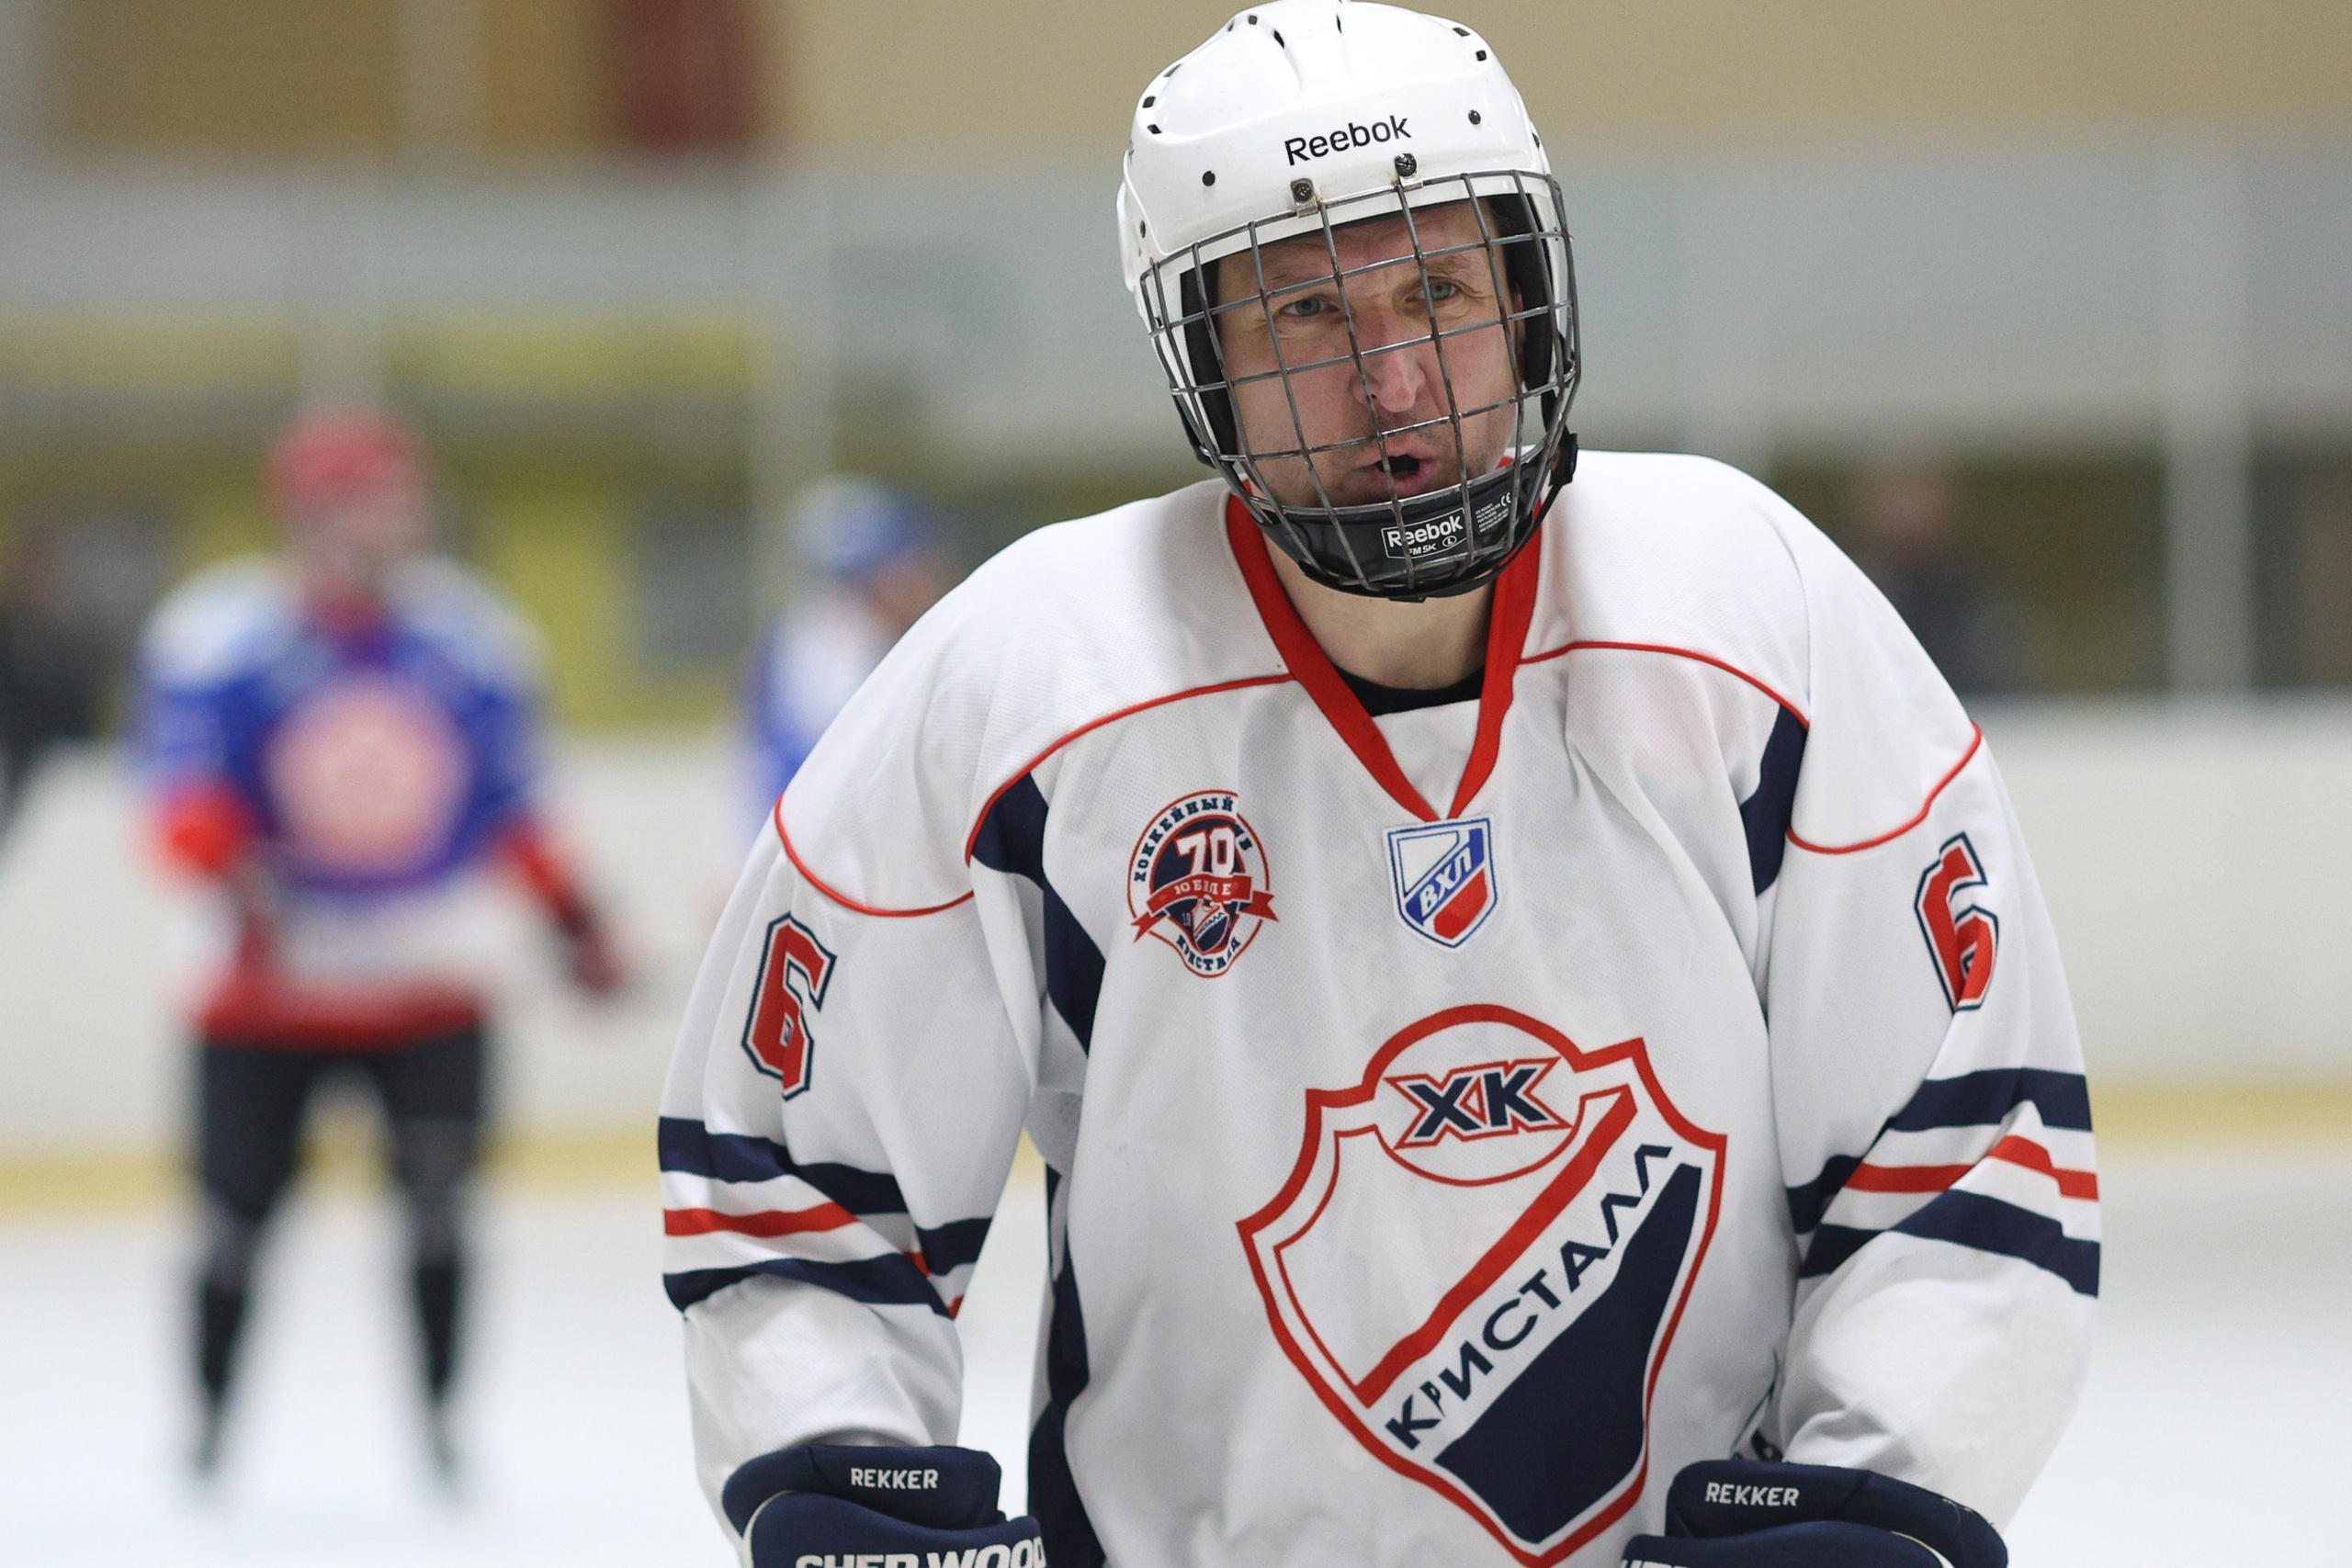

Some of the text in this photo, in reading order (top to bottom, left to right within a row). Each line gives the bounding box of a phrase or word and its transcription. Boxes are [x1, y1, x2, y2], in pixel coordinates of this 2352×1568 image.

[1284, 115, 1412, 166] Reebok
[1387, 514, 1464, 547] Reebok
[1134, 796, 1233, 882] ХОККЕЙНЫЙ
[1175, 827, 1236, 877] 70
[1419, 846, 1473, 918] ВХЛ
[1914, 831, 1999, 1019] 6
[741, 911, 838, 1101] 6
[1396, 1062, 1561, 1144] ХК
[1385, 1144, 1673, 1450] КРИСТАЛЛ
[851, 1467, 939, 1490] REKKER
[1704, 1482, 1800, 1506] REKKER
